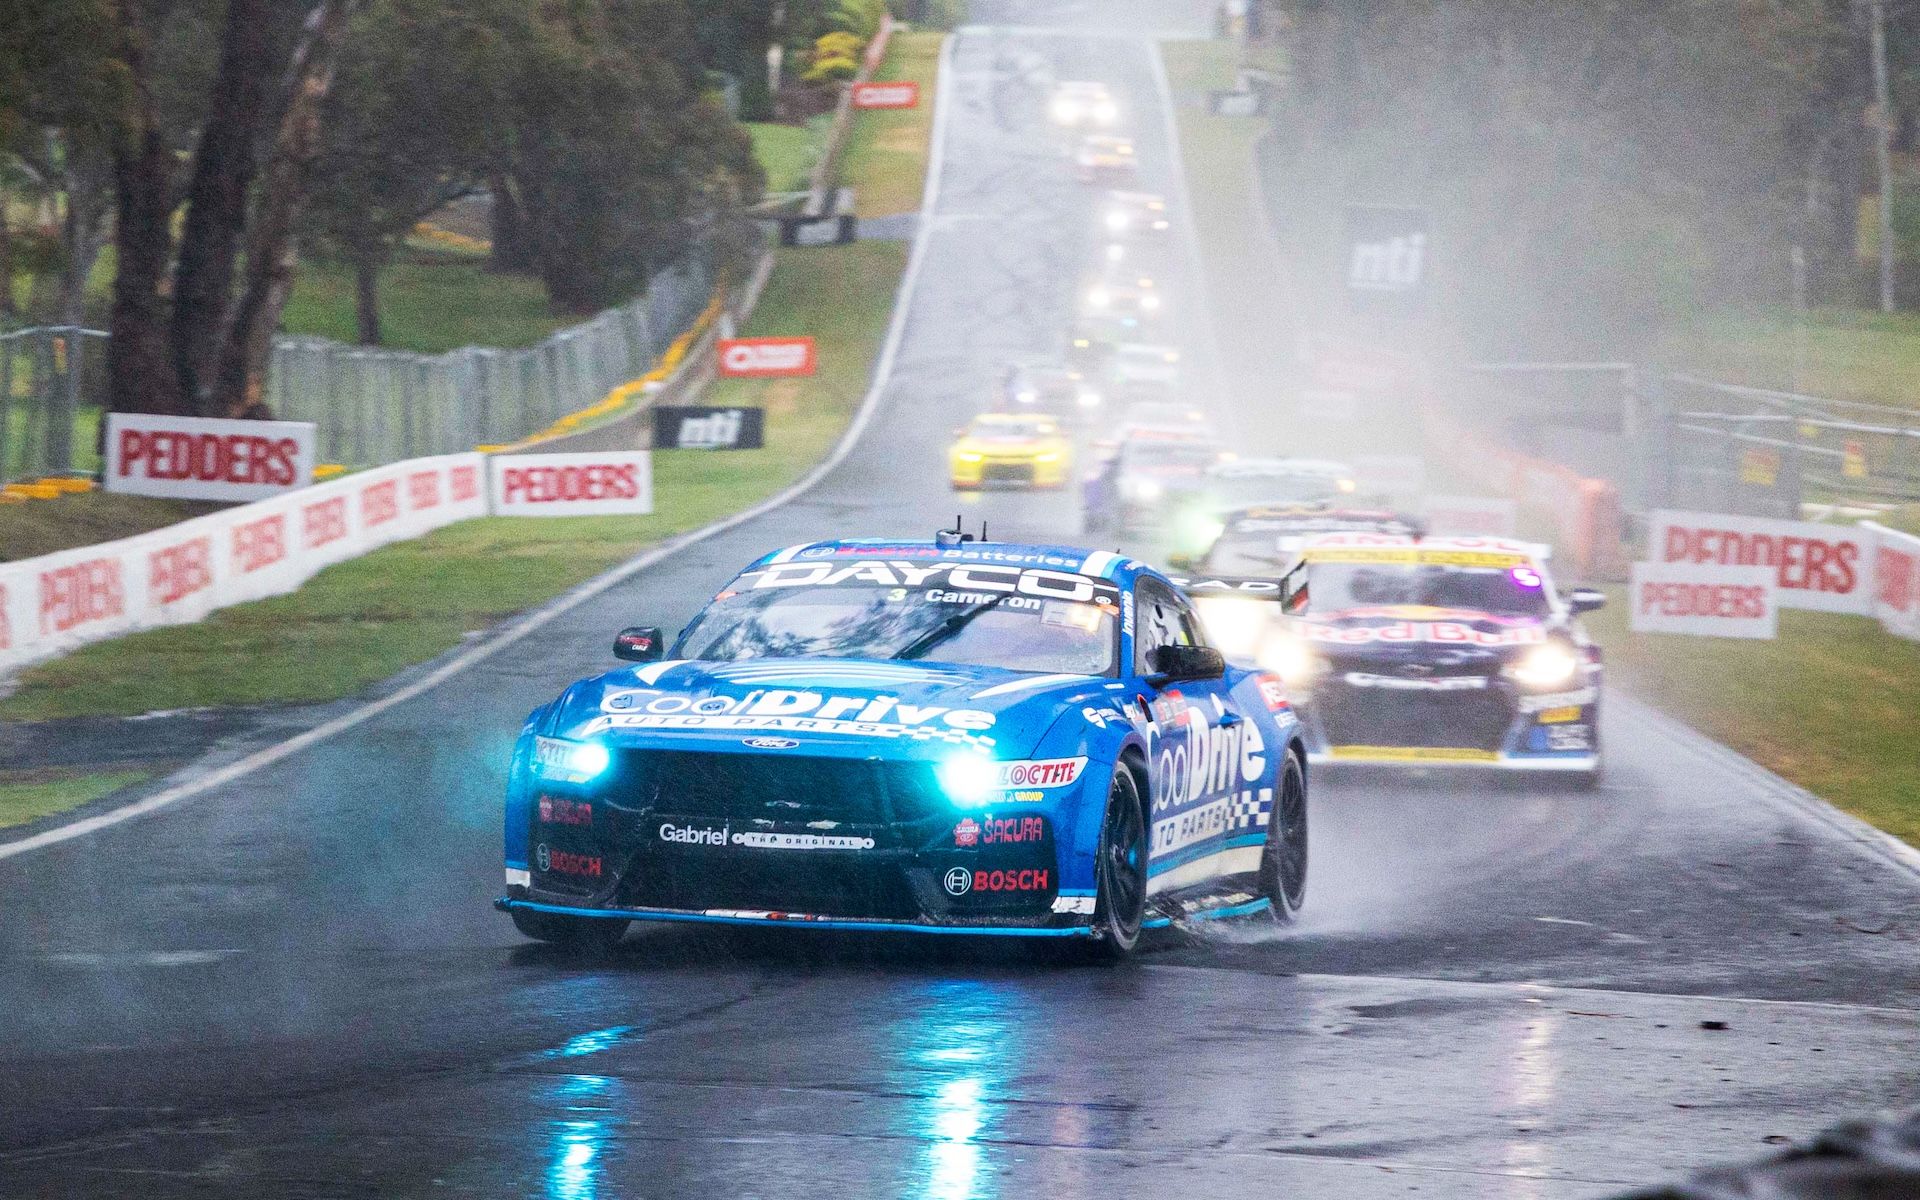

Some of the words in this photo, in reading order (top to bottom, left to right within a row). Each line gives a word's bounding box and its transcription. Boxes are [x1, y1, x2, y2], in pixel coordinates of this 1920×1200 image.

[118, 429, 298, 486] PEDDERS
[504, 463, 638, 503] PEDDERS
[943, 549, 1079, 567] Batteries
[752, 560, 1095, 602] DAYCO
[887, 588, 908, 601] 3
[925, 588, 1042, 610] Cameron
[600, 689, 997, 731] CoolDrive
[733, 717, 880, 733] PARTS
[997, 761, 1076, 785] LOCTITE
[659, 823, 728, 846] Gabriel
[750, 834, 778, 844] THE
[785, 835, 855, 847] ORIGINAL
[983, 817, 1043, 844] SAKURA
[973, 869, 1049, 891] BOSCH
